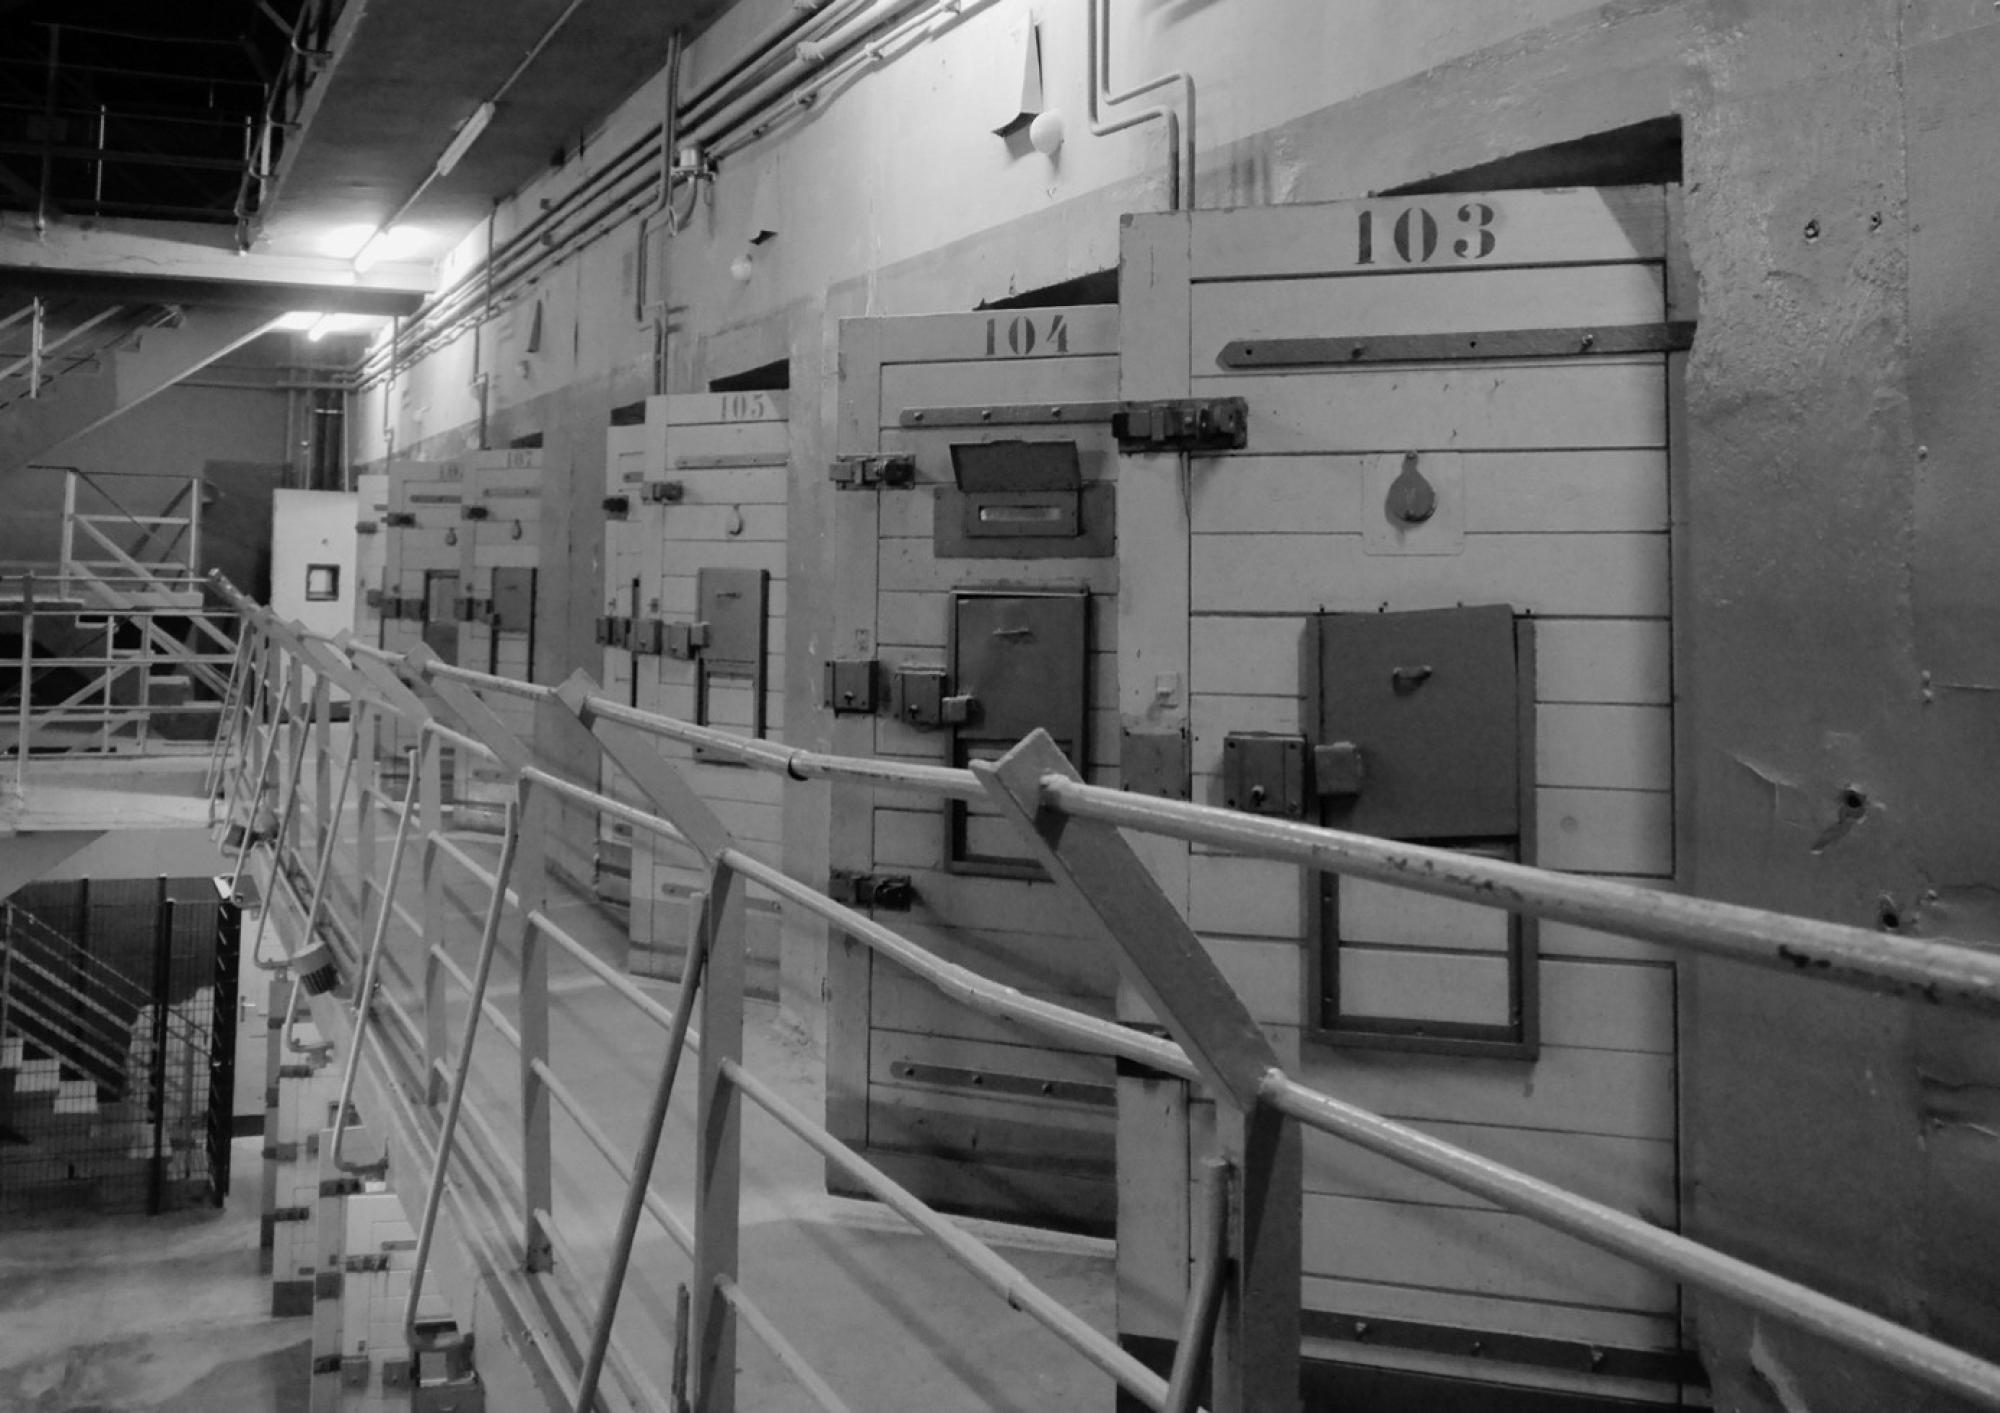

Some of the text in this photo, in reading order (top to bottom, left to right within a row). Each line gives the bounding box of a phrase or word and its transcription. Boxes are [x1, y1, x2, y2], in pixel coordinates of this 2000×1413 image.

[1355, 203, 1496, 265] 103
[984, 314, 1069, 356] 104
[721, 393, 764, 419] 105
